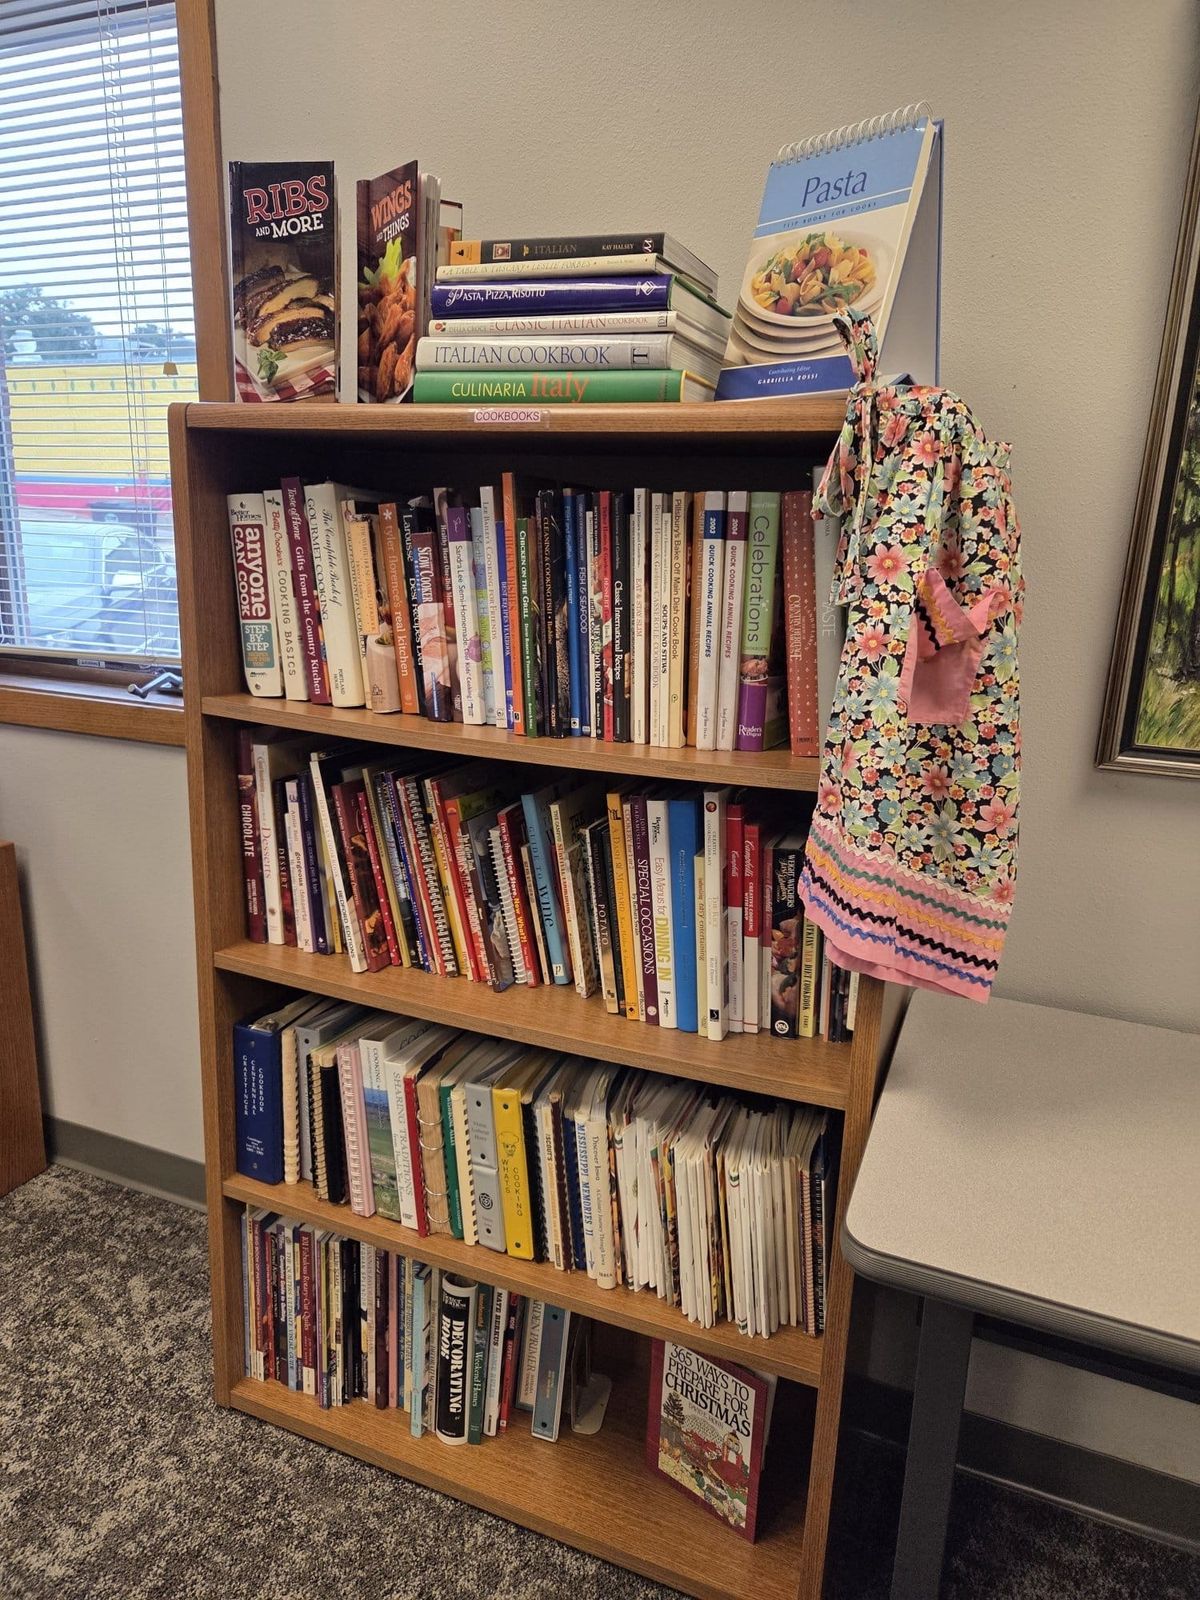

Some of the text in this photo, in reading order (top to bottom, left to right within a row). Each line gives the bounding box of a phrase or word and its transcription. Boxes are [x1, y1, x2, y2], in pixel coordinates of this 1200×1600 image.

[244, 175, 329, 223] RIBS
[370, 179, 412, 231] WINGS
[801, 170, 867, 207] Pasta
[256, 214, 324, 238] AND MORE
[382, 214, 410, 242] THINGS
[783, 209, 845, 229] FLIP BOOKS FOR
[495, 319, 607, 332] CLASSIC ITALIAN
[434, 346, 610, 364] ITALIAN COOKBOOK
[451, 373, 590, 403] CULINARIA Italy
[475, 411, 540, 421] COOKBOOKS
[401, 513, 417, 562] Larousse
[438, 523, 450, 564] Healthy Heart
[708, 516, 717, 534] 2003
[232, 526, 251, 617] CAN COOK
[238, 526, 269, 618] anyone
[306, 497, 329, 621] GOURMET COOKING
[415, 545, 439, 603] SLOW COOKER
[453, 544, 466, 583] Sandra Lee
[517, 529, 531, 619] CHICKEN ON THE GRILL
[541, 516, 552, 614] CLEANING COOKING FISH
[577, 566, 586, 584] FISH
[670, 498, 683, 659] Pillsbury's Bake Off Main Dish Cook Book
[742, 514, 773, 643] Celebrations
[270, 510, 297, 676] Betty COOKING BASICS
[287, 487, 322, 695] Taste of Home Gifts from the Country Kitchen
[383, 524, 412, 677] tyler real kitchen
[484, 545, 498, 640] COOKING FOR FRIENDS
[613, 580, 623, 605] Classic
[634, 577, 642, 594] EAT
[635, 600, 643, 619] STAY
[703, 544, 716, 658] QUICK COOKING ANNUAL RECIPES
[723, 544, 737, 658] QUICK COOKING ANNUAL RECIPES
[578, 594, 587, 634] SEAFOOD
[612, 606, 623, 652] International
[660, 604, 668, 629] SOUPS
[660, 630, 668, 647] AND
[246, 642, 270, 651] STEP
[592, 623, 601, 693] MEAT BOOK
[612, 653, 622, 680] Recipes
[239, 803, 255, 858] CHOCOLATE
[259, 825, 276, 879] Desserts
[527, 825, 543, 880] GUIDE TO
[277, 847, 288, 889] DESSERT
[293, 850, 305, 886] gorgeous
[499, 821, 528, 943] I'm in the Wine Now What?!
[786, 854, 796, 907] WEIGHT WATCHERS
[336, 889, 349, 924] BEDFORD
[343, 924, 356, 959] EDITIONS
[596, 903, 609, 945] POTATO
[635, 857, 655, 975] SPECIAL OCCASIONS
[653, 856, 672, 982] Easy Menus for DINING IN
[729, 920, 738, 938] QUICK
[801, 963, 812, 1011] DIET COOKBOOK
[369, 1047, 383, 1083] COOKING
[390, 1070, 415, 1196] SHARING TRADITIONS
[574, 1122, 593, 1225] MISSISSIPPI MEMORIES
[589, 1135, 602, 1181] Discover Iowa
[512, 1167, 523, 1217] COOKING
[300, 1235, 311, 1331] 101 Fabulous Rotary-Cut Quilts
[494, 1291, 503, 1313] NATE
[439, 1313, 452, 1359] BOOK
[492, 1313, 501, 1346] BERKUS
[525, 1331, 540, 1373] PRIMER
[446, 1319, 466, 1413] DECORATING
[471, 1350, 483, 1407] Weekend Homes
[668, 1357, 721, 1401] PREPARE
[724, 1393, 749, 1420] FOR
[670, 1344, 750, 1401] 365 WAYS TO
[665, 1372, 751, 1438] CHRISTMAS
